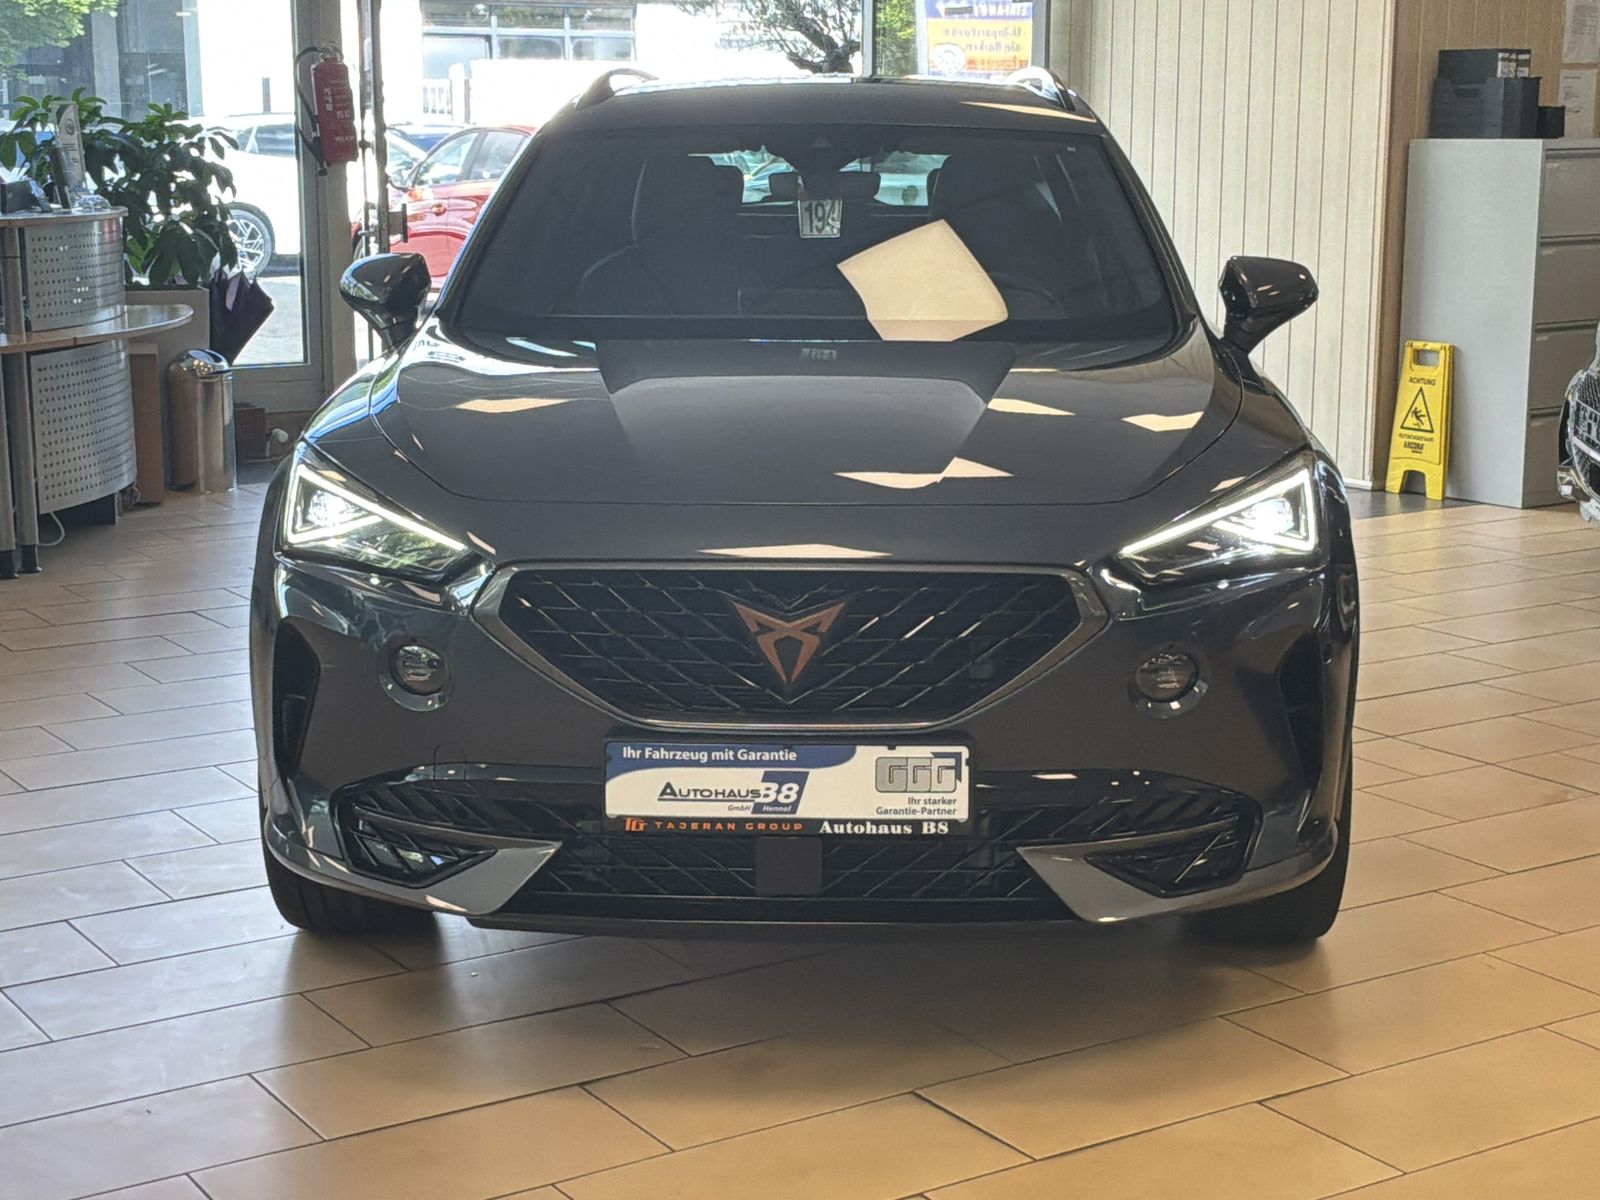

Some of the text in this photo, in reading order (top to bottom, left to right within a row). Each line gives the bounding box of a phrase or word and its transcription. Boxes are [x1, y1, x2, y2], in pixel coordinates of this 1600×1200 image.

[1408, 377, 1436, 386] ACHTUNG
[623, 747, 797, 763] Ihr Fahrzeug mit Garantie
[758, 782, 800, 803] B8
[908, 797, 957, 805] Ihr starker
[728, 804, 751, 812] GmbH
[876, 807, 957, 815] Garantie-Partner
[745, 823, 803, 831] GROUP
[819, 821, 949, 835] Autohaus B8
